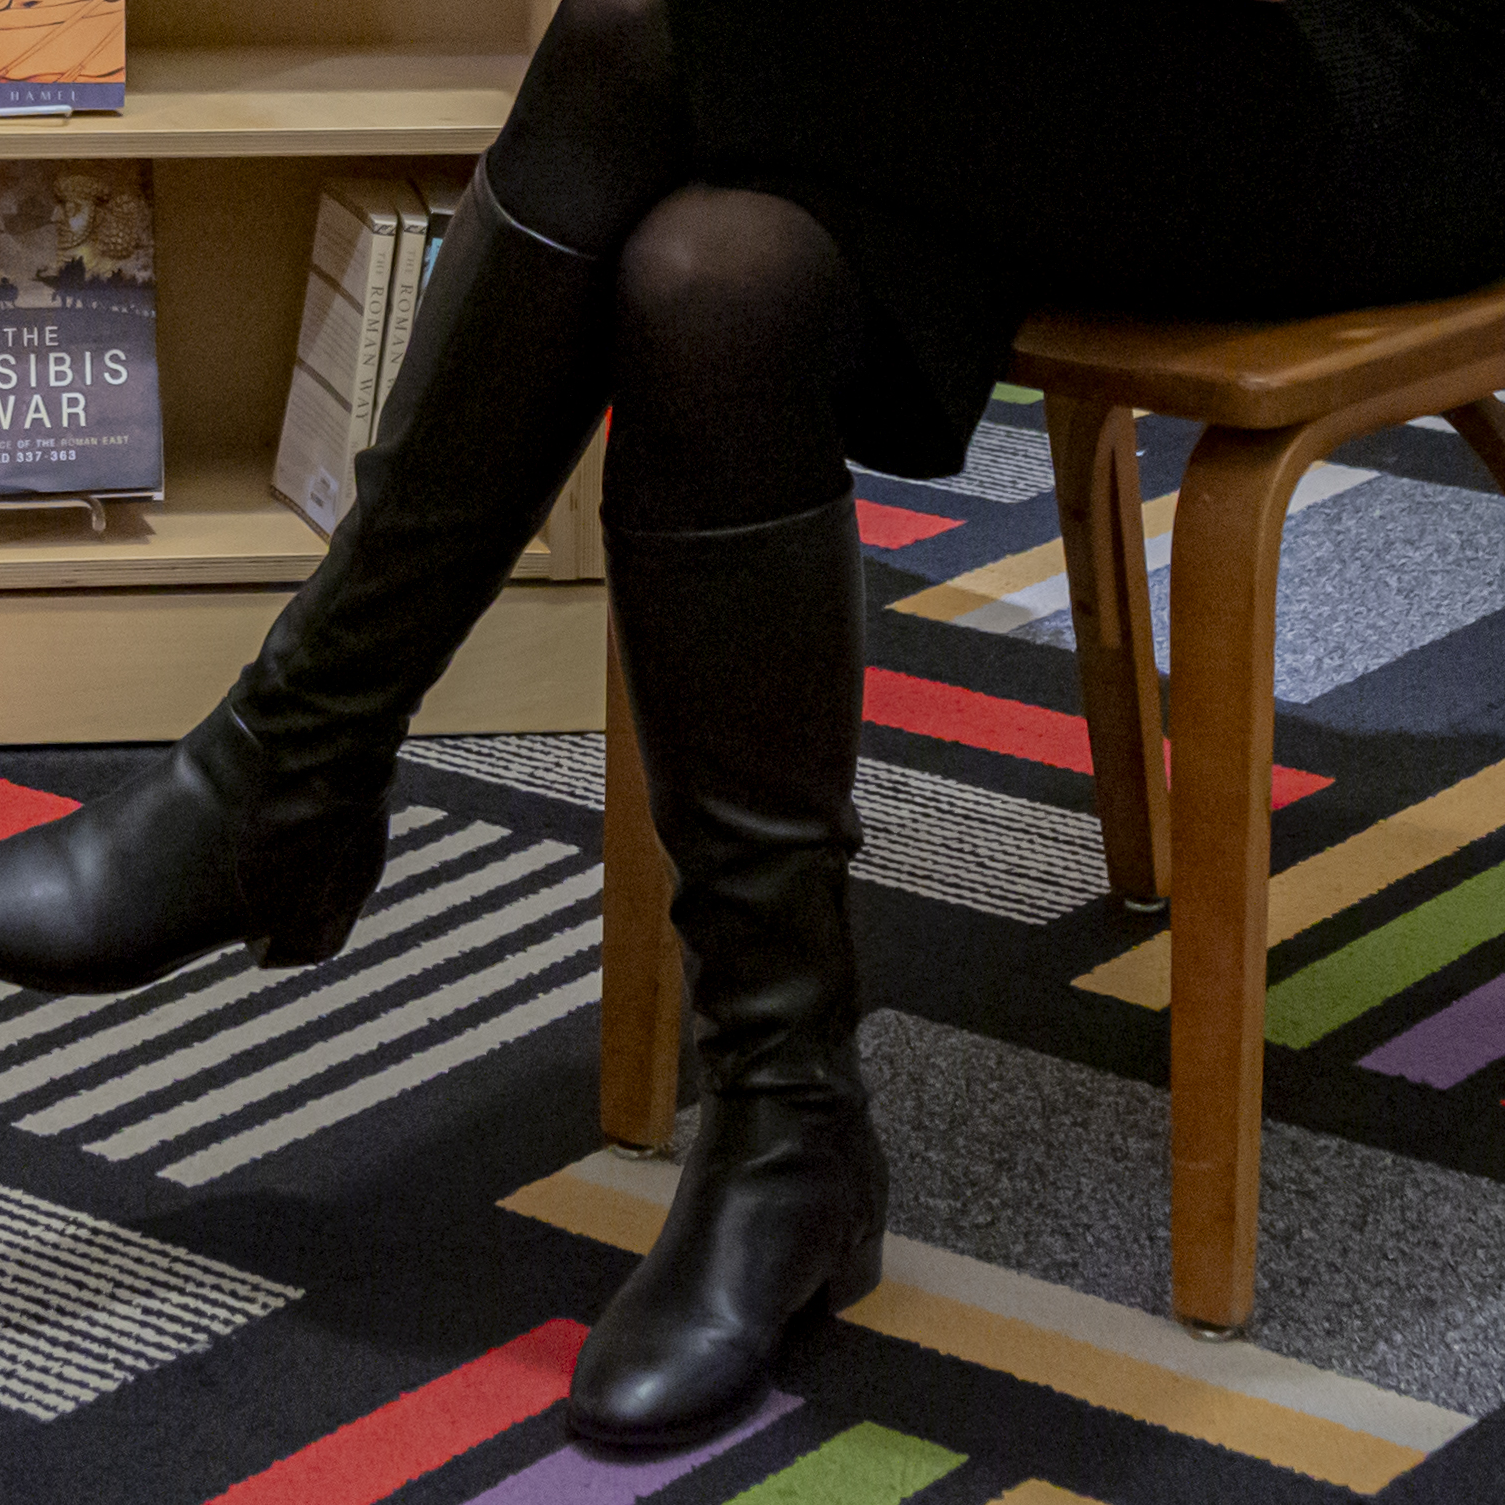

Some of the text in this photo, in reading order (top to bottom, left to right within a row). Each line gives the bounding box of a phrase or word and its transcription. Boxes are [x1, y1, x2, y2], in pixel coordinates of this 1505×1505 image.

[10, 90, 79, 102] HAMEL
[4, 326, 59, 347] THE
[390, 284, 414, 365] ROMAN
[355, 284, 384, 423] ROMAN WAY
